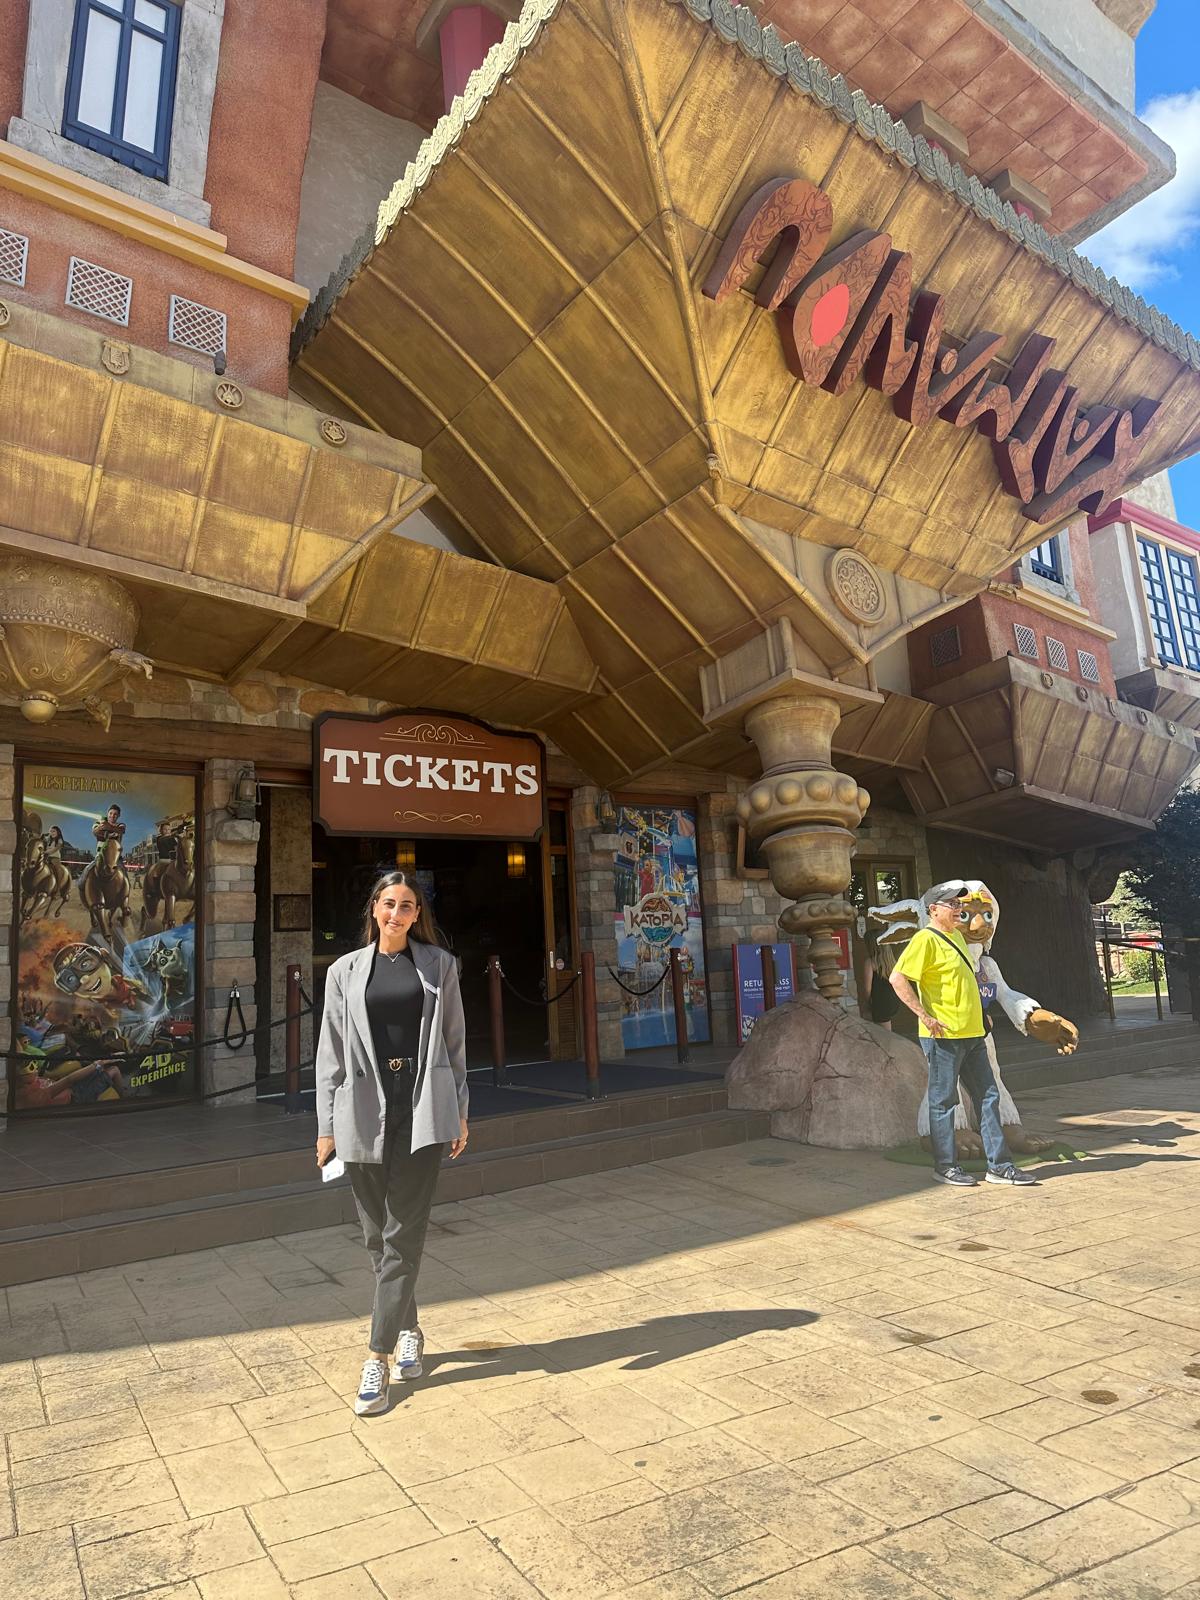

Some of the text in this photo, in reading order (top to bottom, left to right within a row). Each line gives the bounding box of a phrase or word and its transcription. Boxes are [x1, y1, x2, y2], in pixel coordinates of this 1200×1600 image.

[323, 748, 539, 795] TICKETS
[630, 911, 684, 929] KATOPIA
[743, 979, 763, 988] RETU
[139, 1053, 172, 1070] 4D
[130, 1062, 186, 1087] EXPERIENCE
